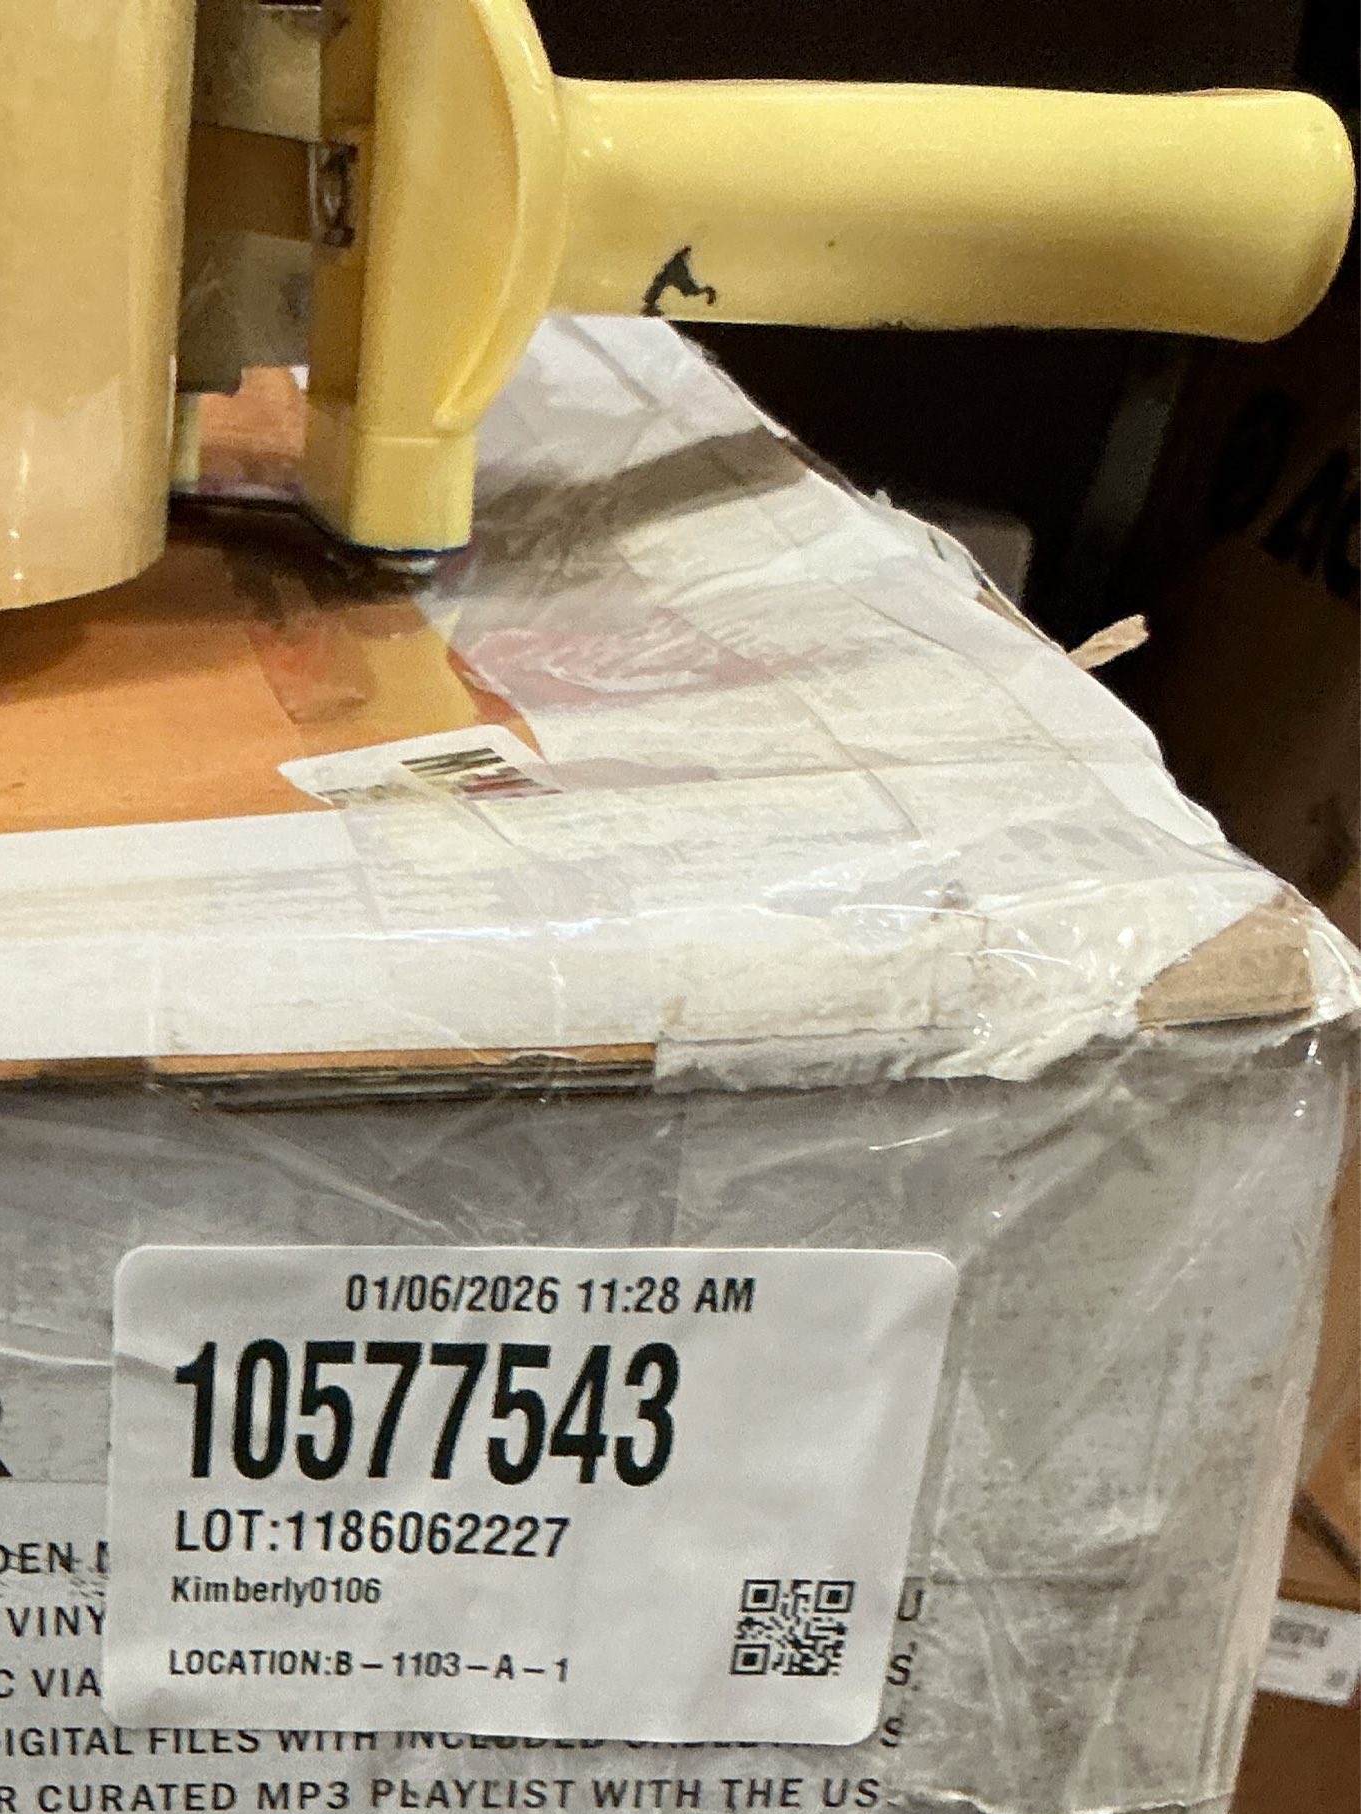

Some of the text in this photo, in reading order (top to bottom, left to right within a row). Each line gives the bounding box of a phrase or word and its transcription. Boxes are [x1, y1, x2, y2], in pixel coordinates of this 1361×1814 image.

[345, 1273, 755, 1313] 01/06/2026 11:28 AM
[174, 1338, 680, 1487] 10577543
[174, 1508, 571, 1560] LOT:1186062227
[170, 1575, 383, 1609] Kimberly0106
[31, 1666, 103, 1699] VIA
[148, 1728, 260, 1754] FILES
[38, 1782, 239, 1814] CURATED
[256, 1781, 351, 1811] MP3
[370, 1777, 575, 1810] PLAYLIST
[592, 1777, 702, 1809] WITH
[720, 1777, 803, 1809] THE
